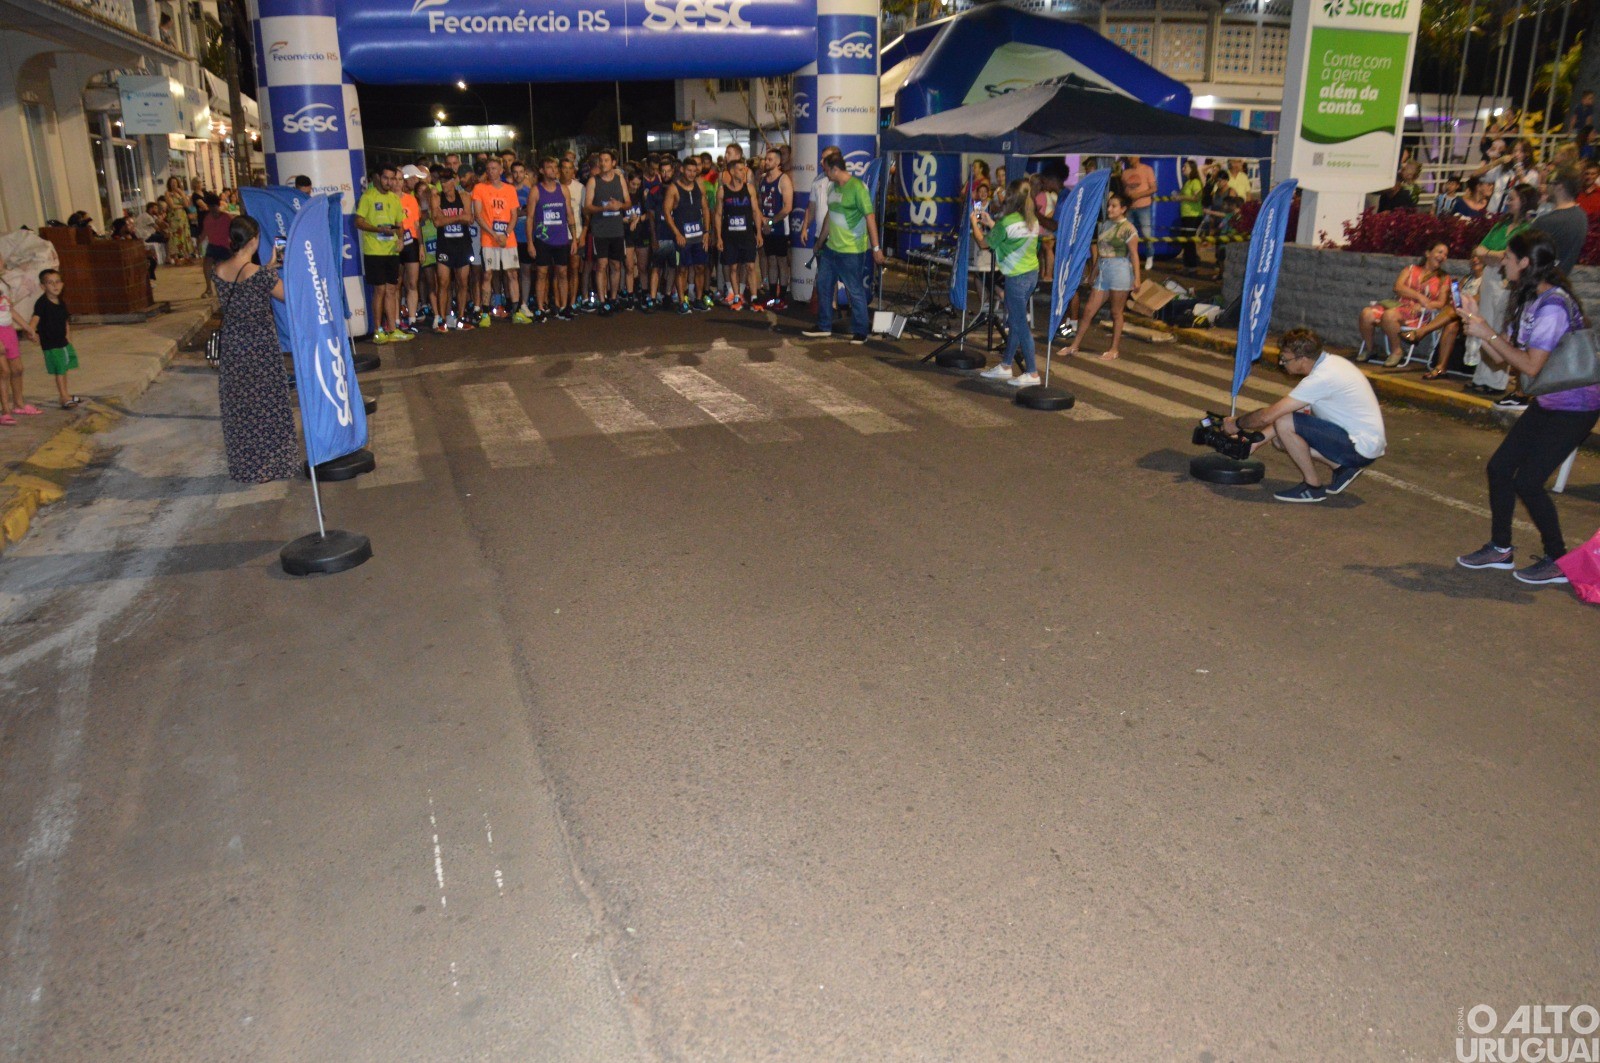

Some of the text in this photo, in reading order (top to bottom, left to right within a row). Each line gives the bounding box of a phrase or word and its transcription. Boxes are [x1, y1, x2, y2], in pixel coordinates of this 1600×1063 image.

[642, 0, 752, 31] Sesc
[1346, 0, 1409, 18] Sicredi
[428, 10, 610, 33] Fecomércio RS
[273, 52, 324, 61] Fecomércio
[828, 41, 873, 58] Sesc
[1323, 50, 1392, 70] Conte com
[1321, 67, 1372, 85] a gente
[1319, 81, 1380, 101] além da
[826, 105, 868, 113] Fecomércio
[1317, 101, 1365, 115] conta.
[282, 113, 338, 134] Sesc
[341, 184, 351, 192] RS
[910, 151, 938, 226] Ses
[446, 224, 462, 232] 035
[304, 240, 329, 325] Fecomércio
[327, 336, 353, 428] Sesc
